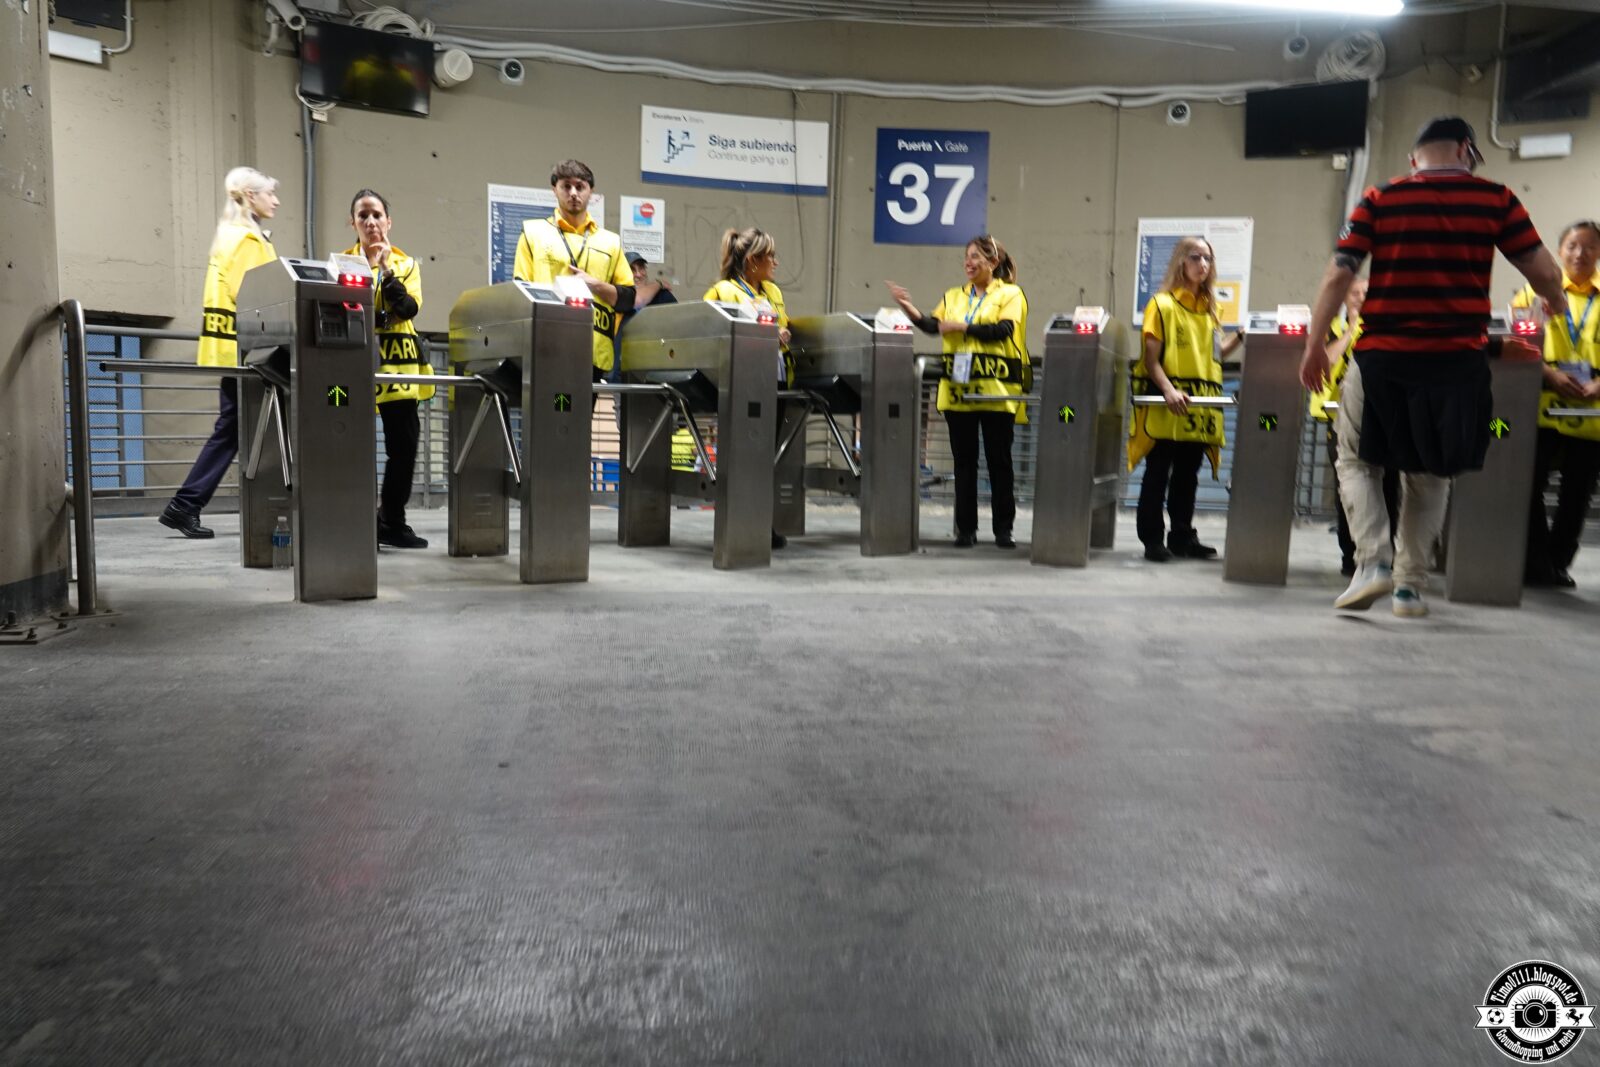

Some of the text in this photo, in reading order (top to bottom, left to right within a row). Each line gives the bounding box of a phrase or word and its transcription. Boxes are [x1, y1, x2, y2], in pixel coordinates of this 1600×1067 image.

[708, 134, 797, 153] Siga subiendo
[898, 138, 933, 152] Puerta
[944, 140, 969, 153] Gate
[708, 149, 789, 166] Continue going up
[886, 162, 975, 226] 37
